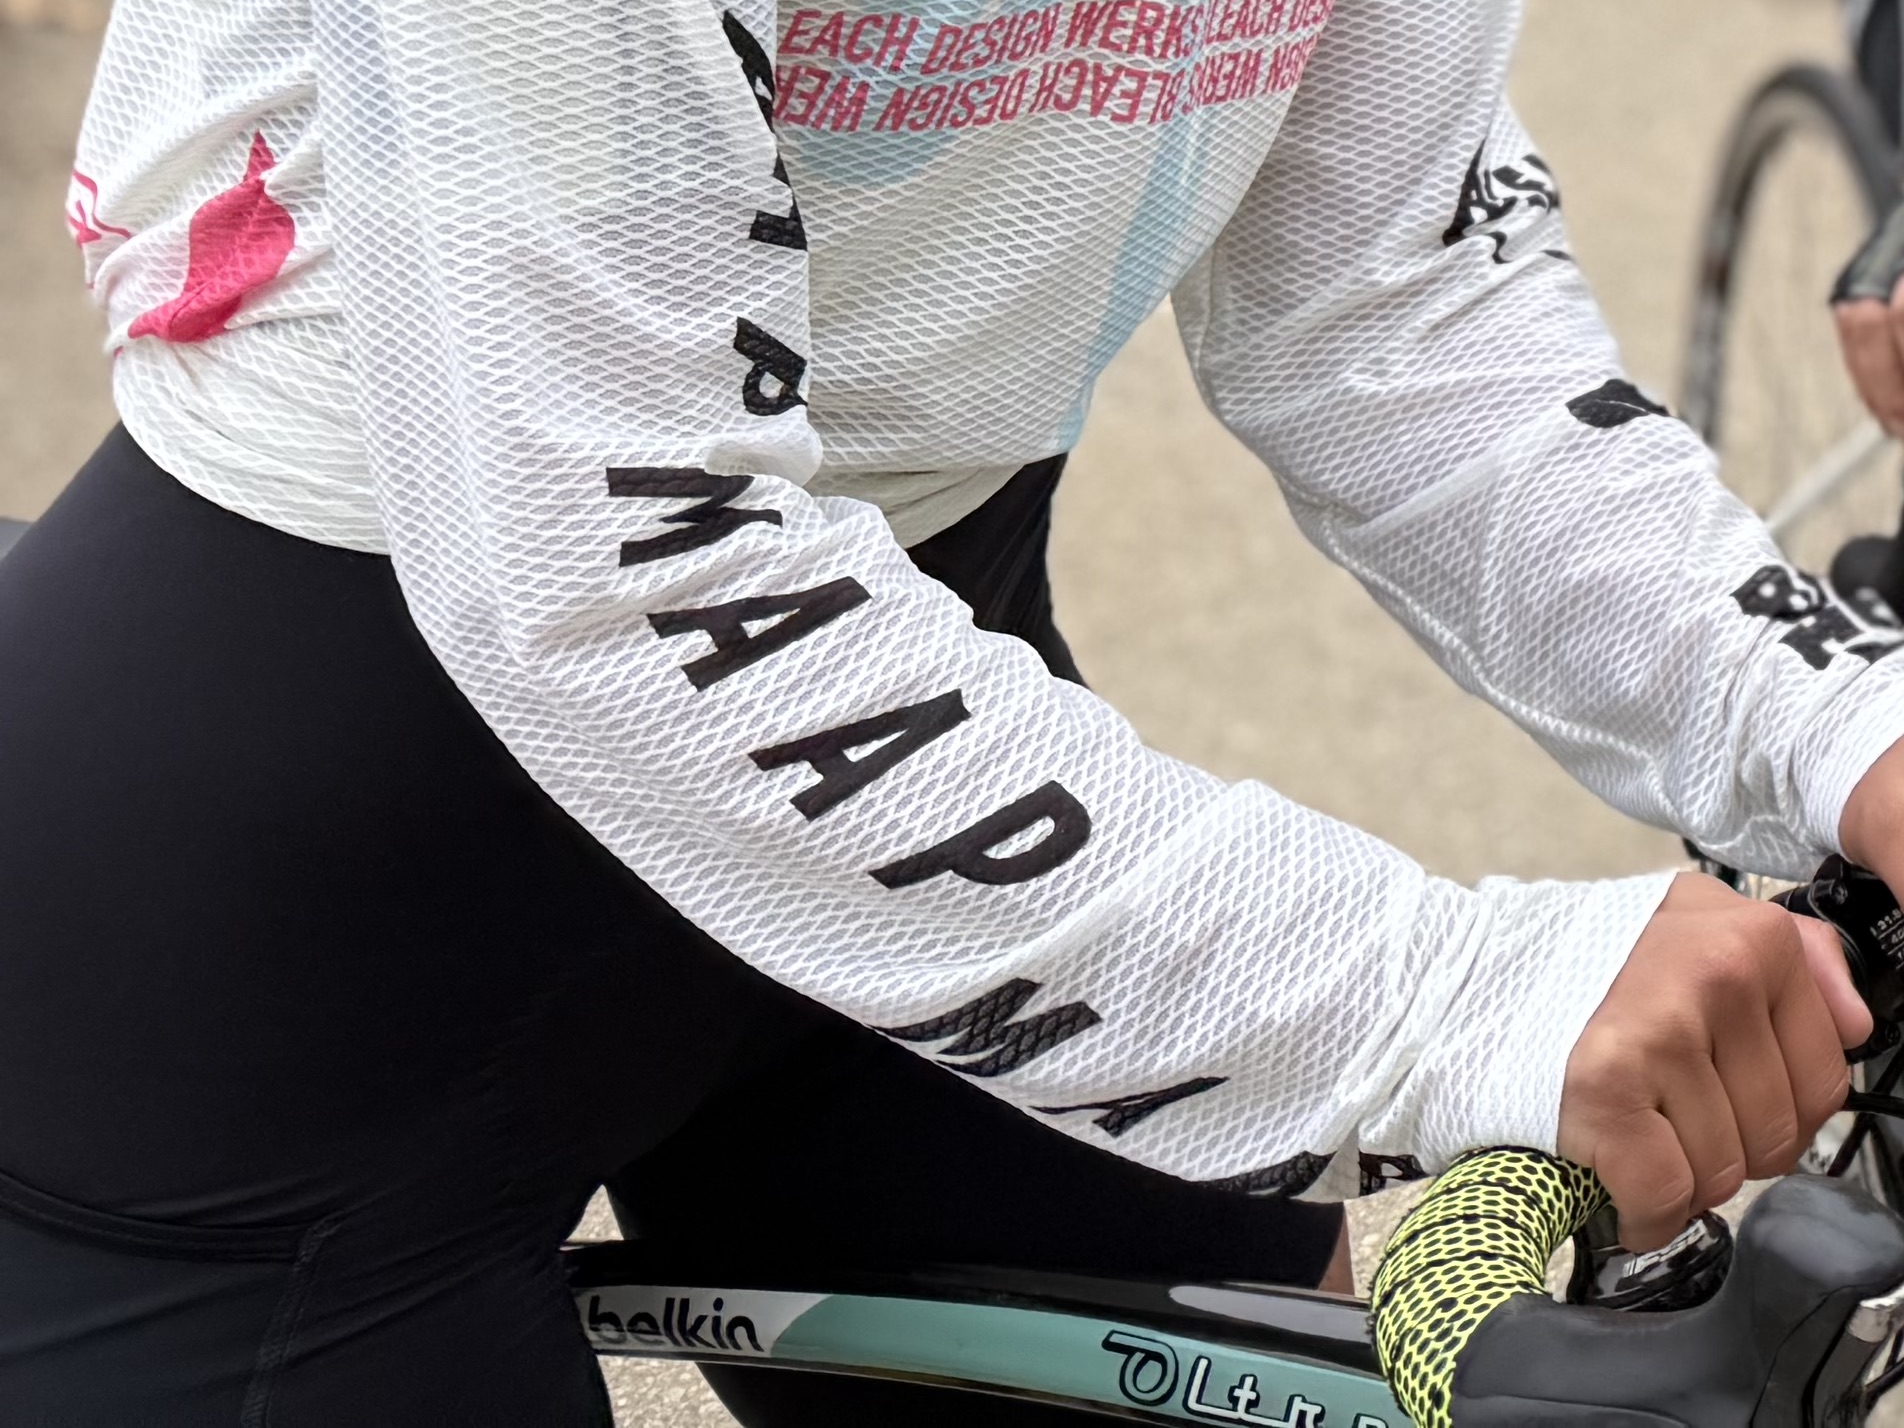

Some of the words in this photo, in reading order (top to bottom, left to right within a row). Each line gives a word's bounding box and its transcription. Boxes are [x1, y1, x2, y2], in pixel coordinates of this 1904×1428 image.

[778, 9, 921, 72] EACH
[920, 2, 1064, 76] DESIGN
[876, 68, 1030, 132] DESIGN
[1029, 58, 1184, 126] BLEACH
[606, 466, 1092, 889] MAAP
[588, 1294, 765, 1353] belkin
